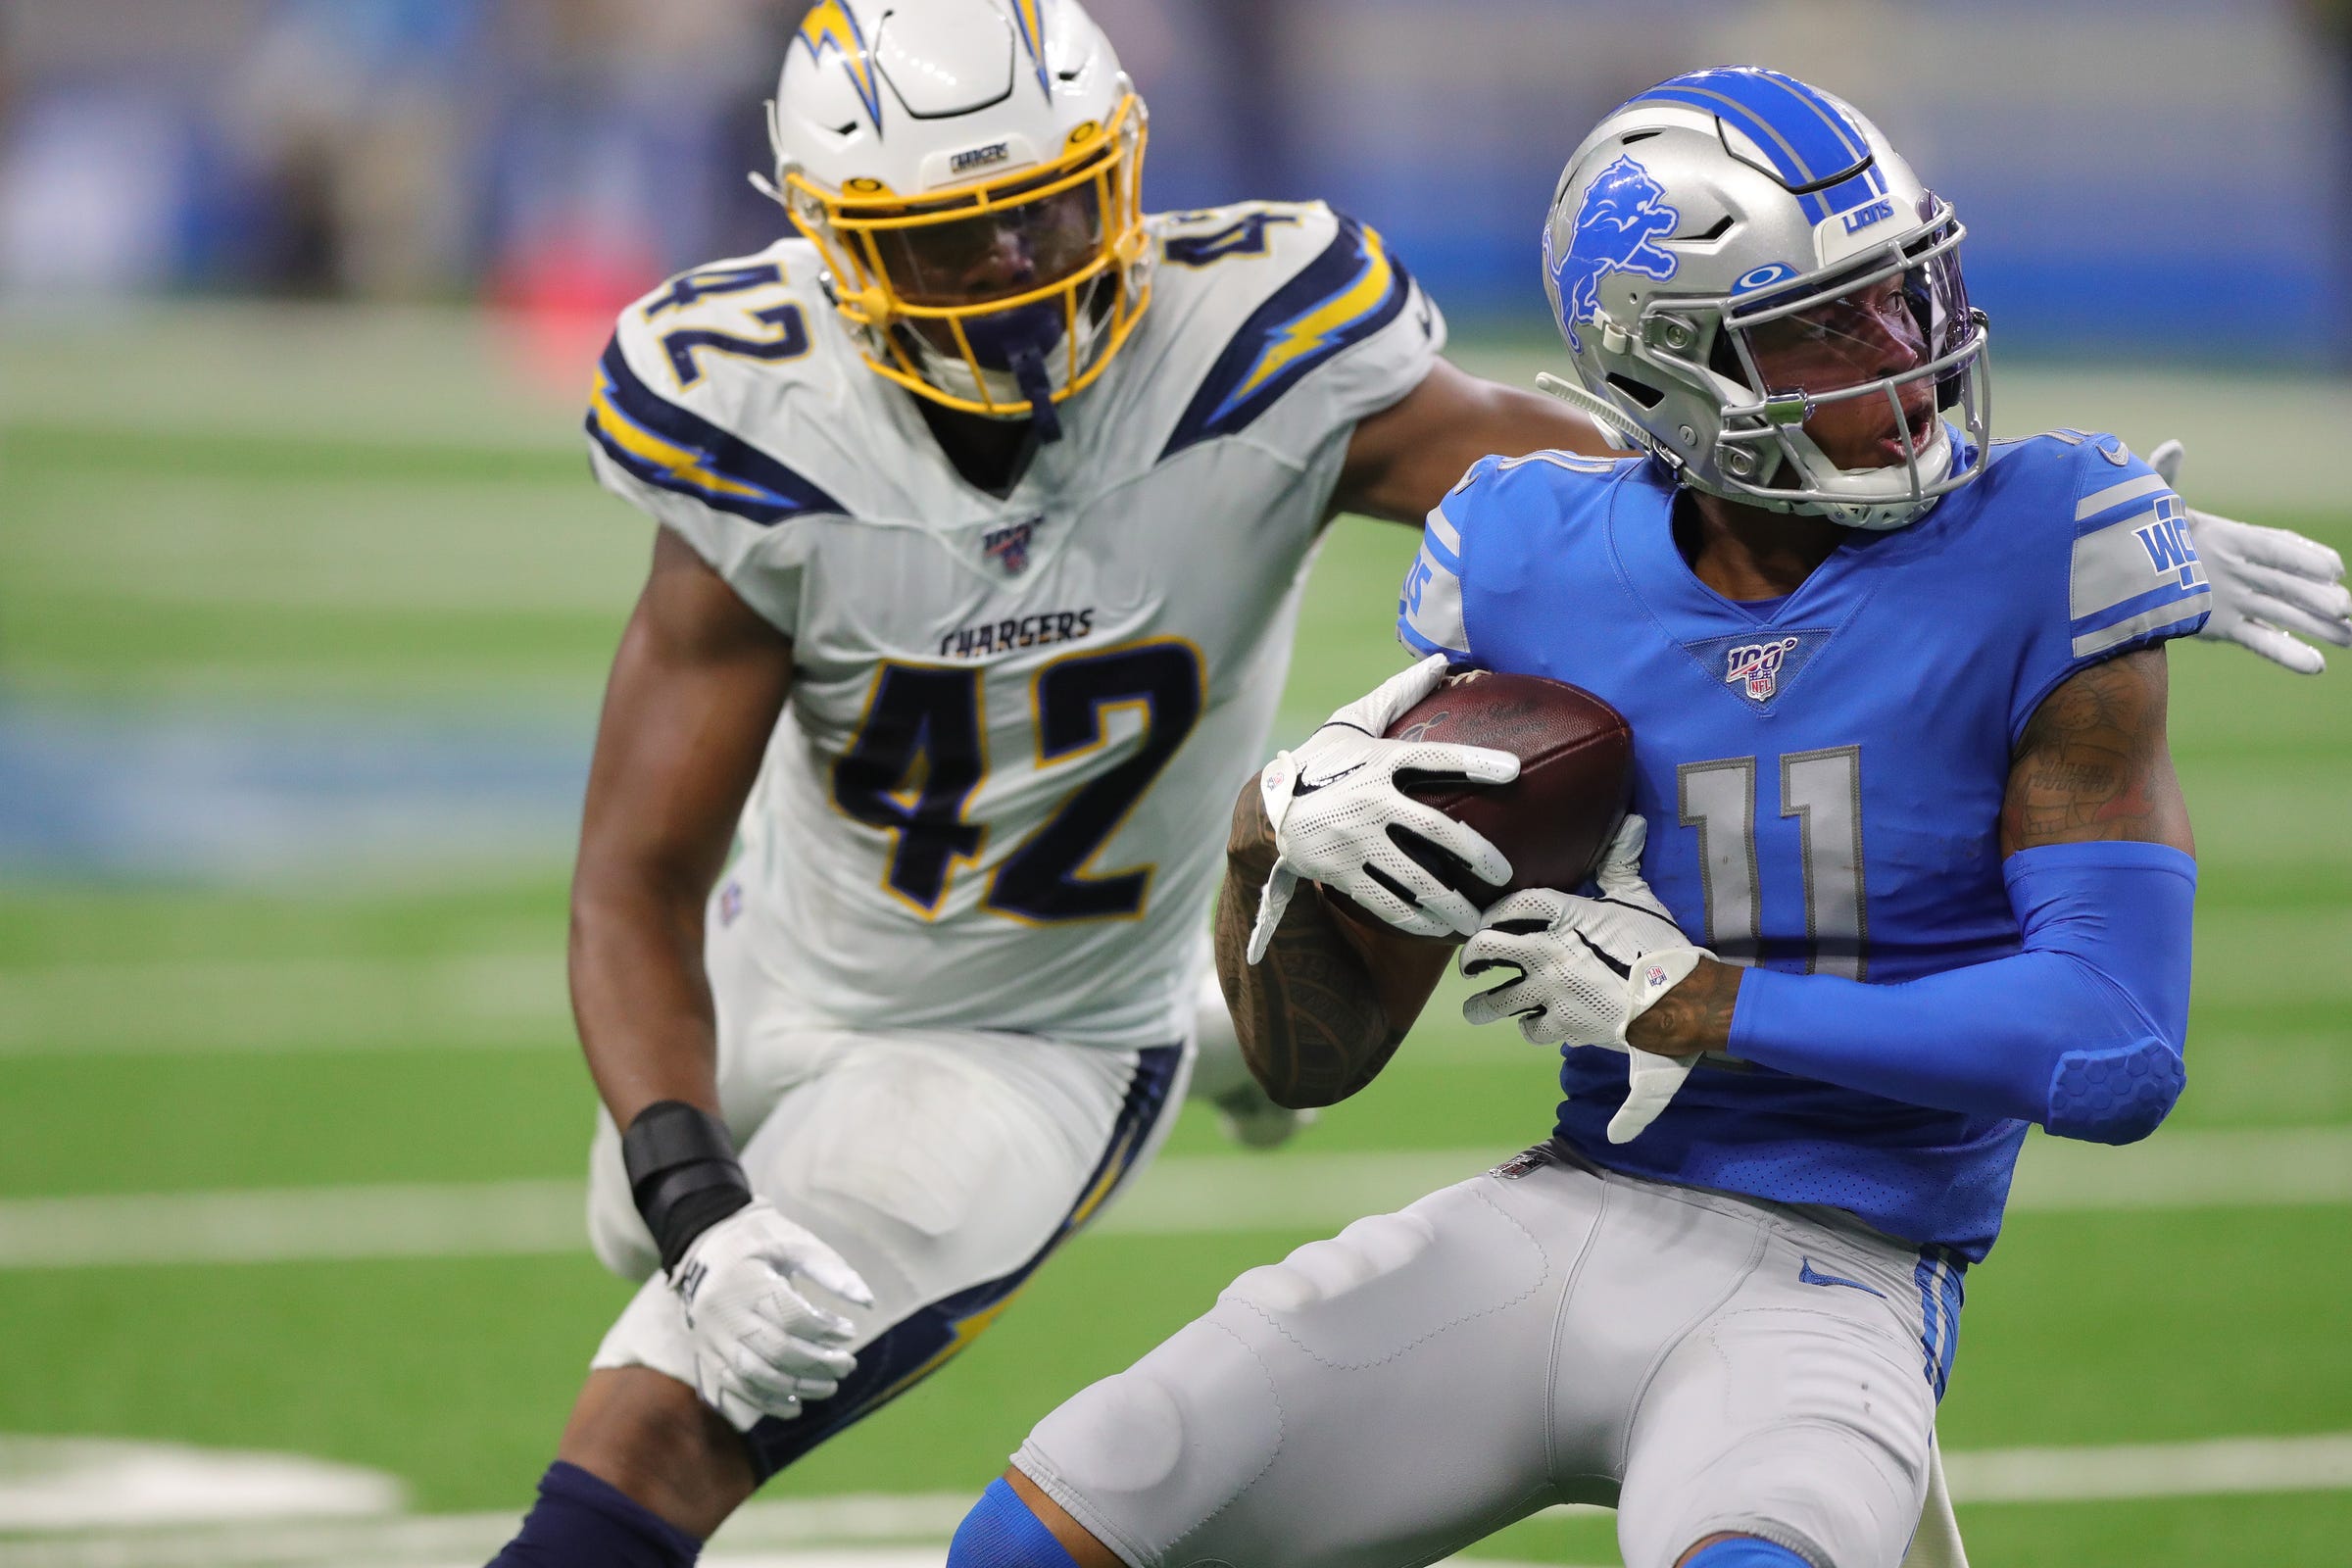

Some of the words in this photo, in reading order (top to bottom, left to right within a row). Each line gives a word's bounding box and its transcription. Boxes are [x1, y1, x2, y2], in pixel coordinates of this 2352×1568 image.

[1842, 198, 1894, 234] LIONS
[641, 262, 812, 393] 42
[941, 608, 1095, 658] CHARGERS
[1751, 680, 1771, 693] NFL
[829, 635, 1207, 928] 42
[1677, 744, 1870, 984] 11
